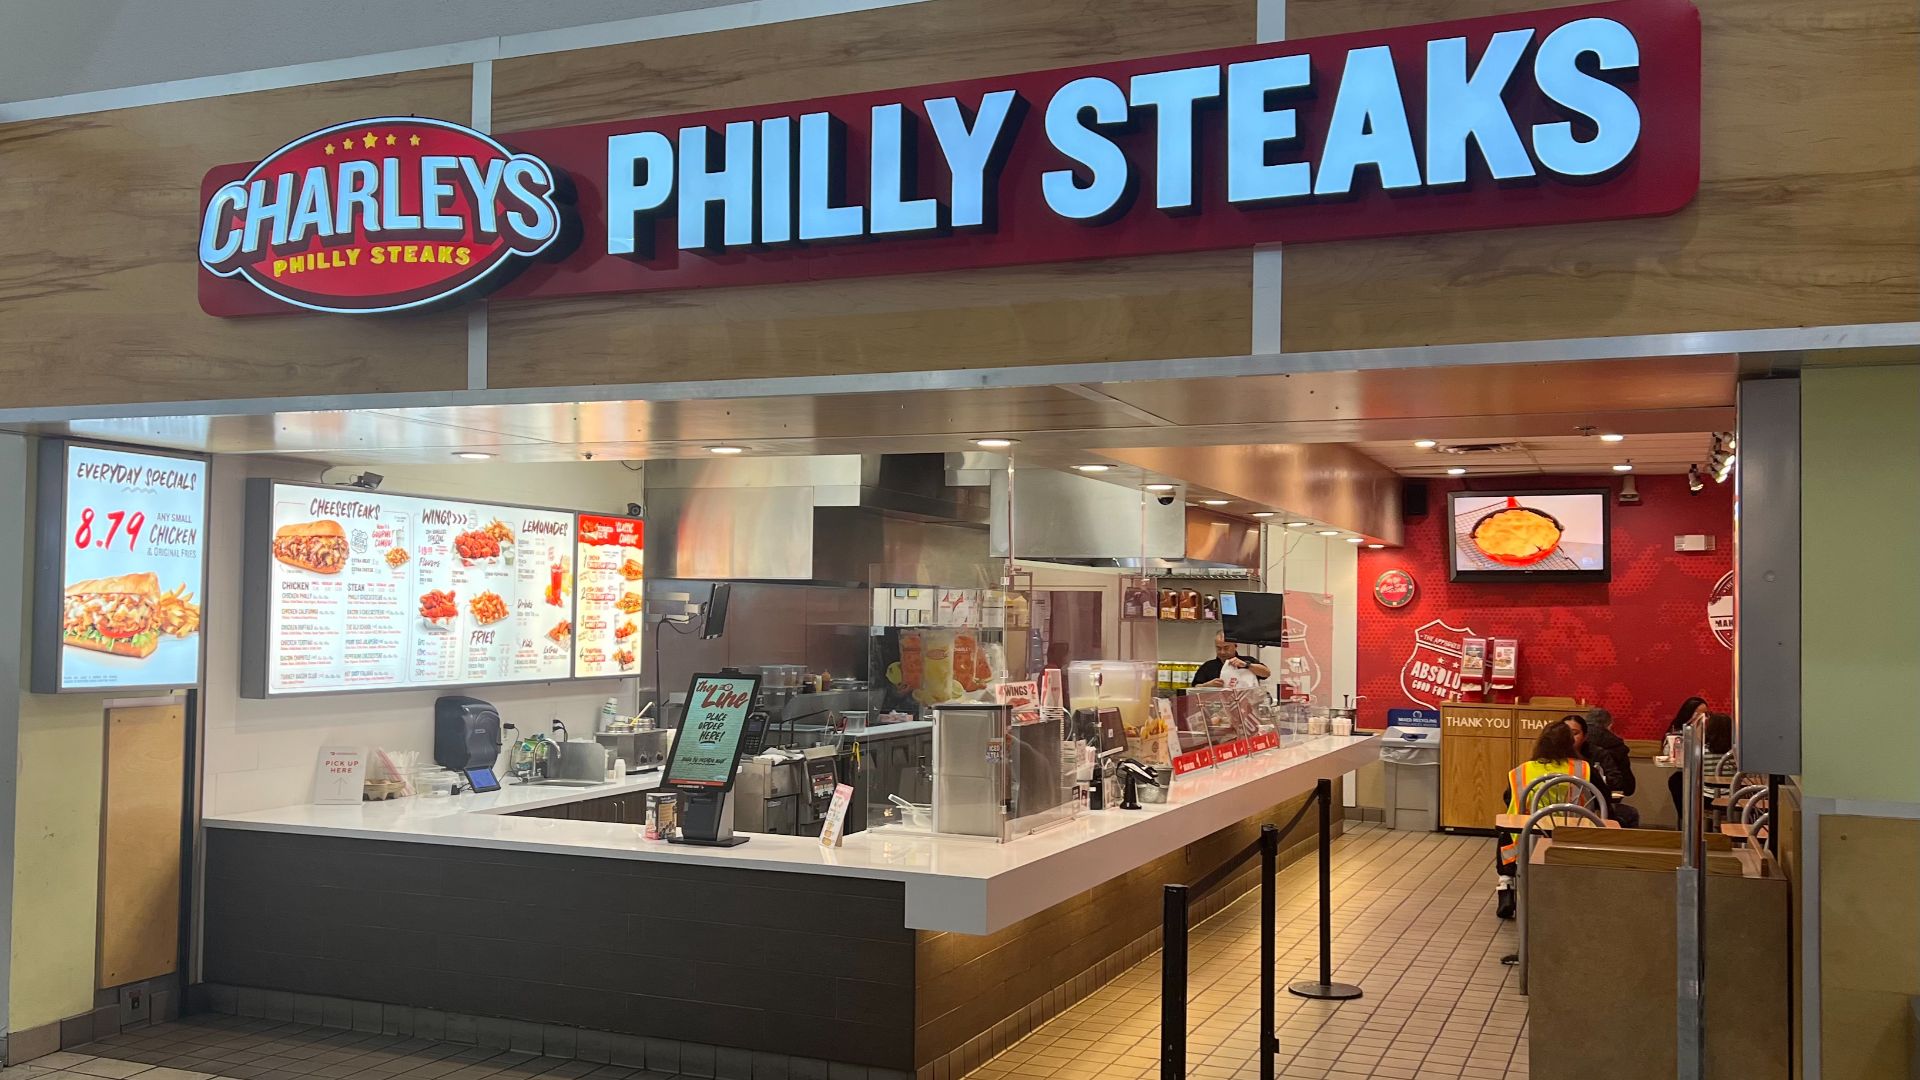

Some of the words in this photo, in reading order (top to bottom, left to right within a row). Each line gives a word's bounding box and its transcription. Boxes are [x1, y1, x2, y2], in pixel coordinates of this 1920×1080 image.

[608, 89, 1017, 255] PHILLY
[1042, 17, 1640, 219] STEAKS
[200, 156, 555, 264] CHARLEYS
[273, 249, 360, 277] PHILLY
[371, 245, 471, 266] STEAKS
[76, 462, 143, 487] EVERYDAY
[144, 467, 197, 491] SPECIALS
[157, 512, 170, 522] ANY
[171, 513, 192, 524] SMALL
[310, 498, 381, 520] CHEESESTEAKS
[422, 508, 452, 526] WINGS
[74, 507, 146, 551] 8.79
[149, 524, 197, 546] CHICKEN
[522, 519, 568, 537] LEMONADES
[282, 581, 309, 591] CHICKEN
[347, 583, 365, 592] STEAK
[469, 630, 496, 646] FRIES
[701, 684, 748, 709] Line
[1004, 685, 1028, 697] WINGS
[1412, 680, 1431, 693] GOOD
[1432, 685, 1447, 698] FOR
[706, 712, 728, 721] PLACE
[1446, 716, 1482, 728] THANK
[1485, 717, 1511, 729] YOU
[1521, 719, 1554, 730] THAN
[698, 721, 724, 731] ORDER
[699, 731, 726, 742] HERE!
